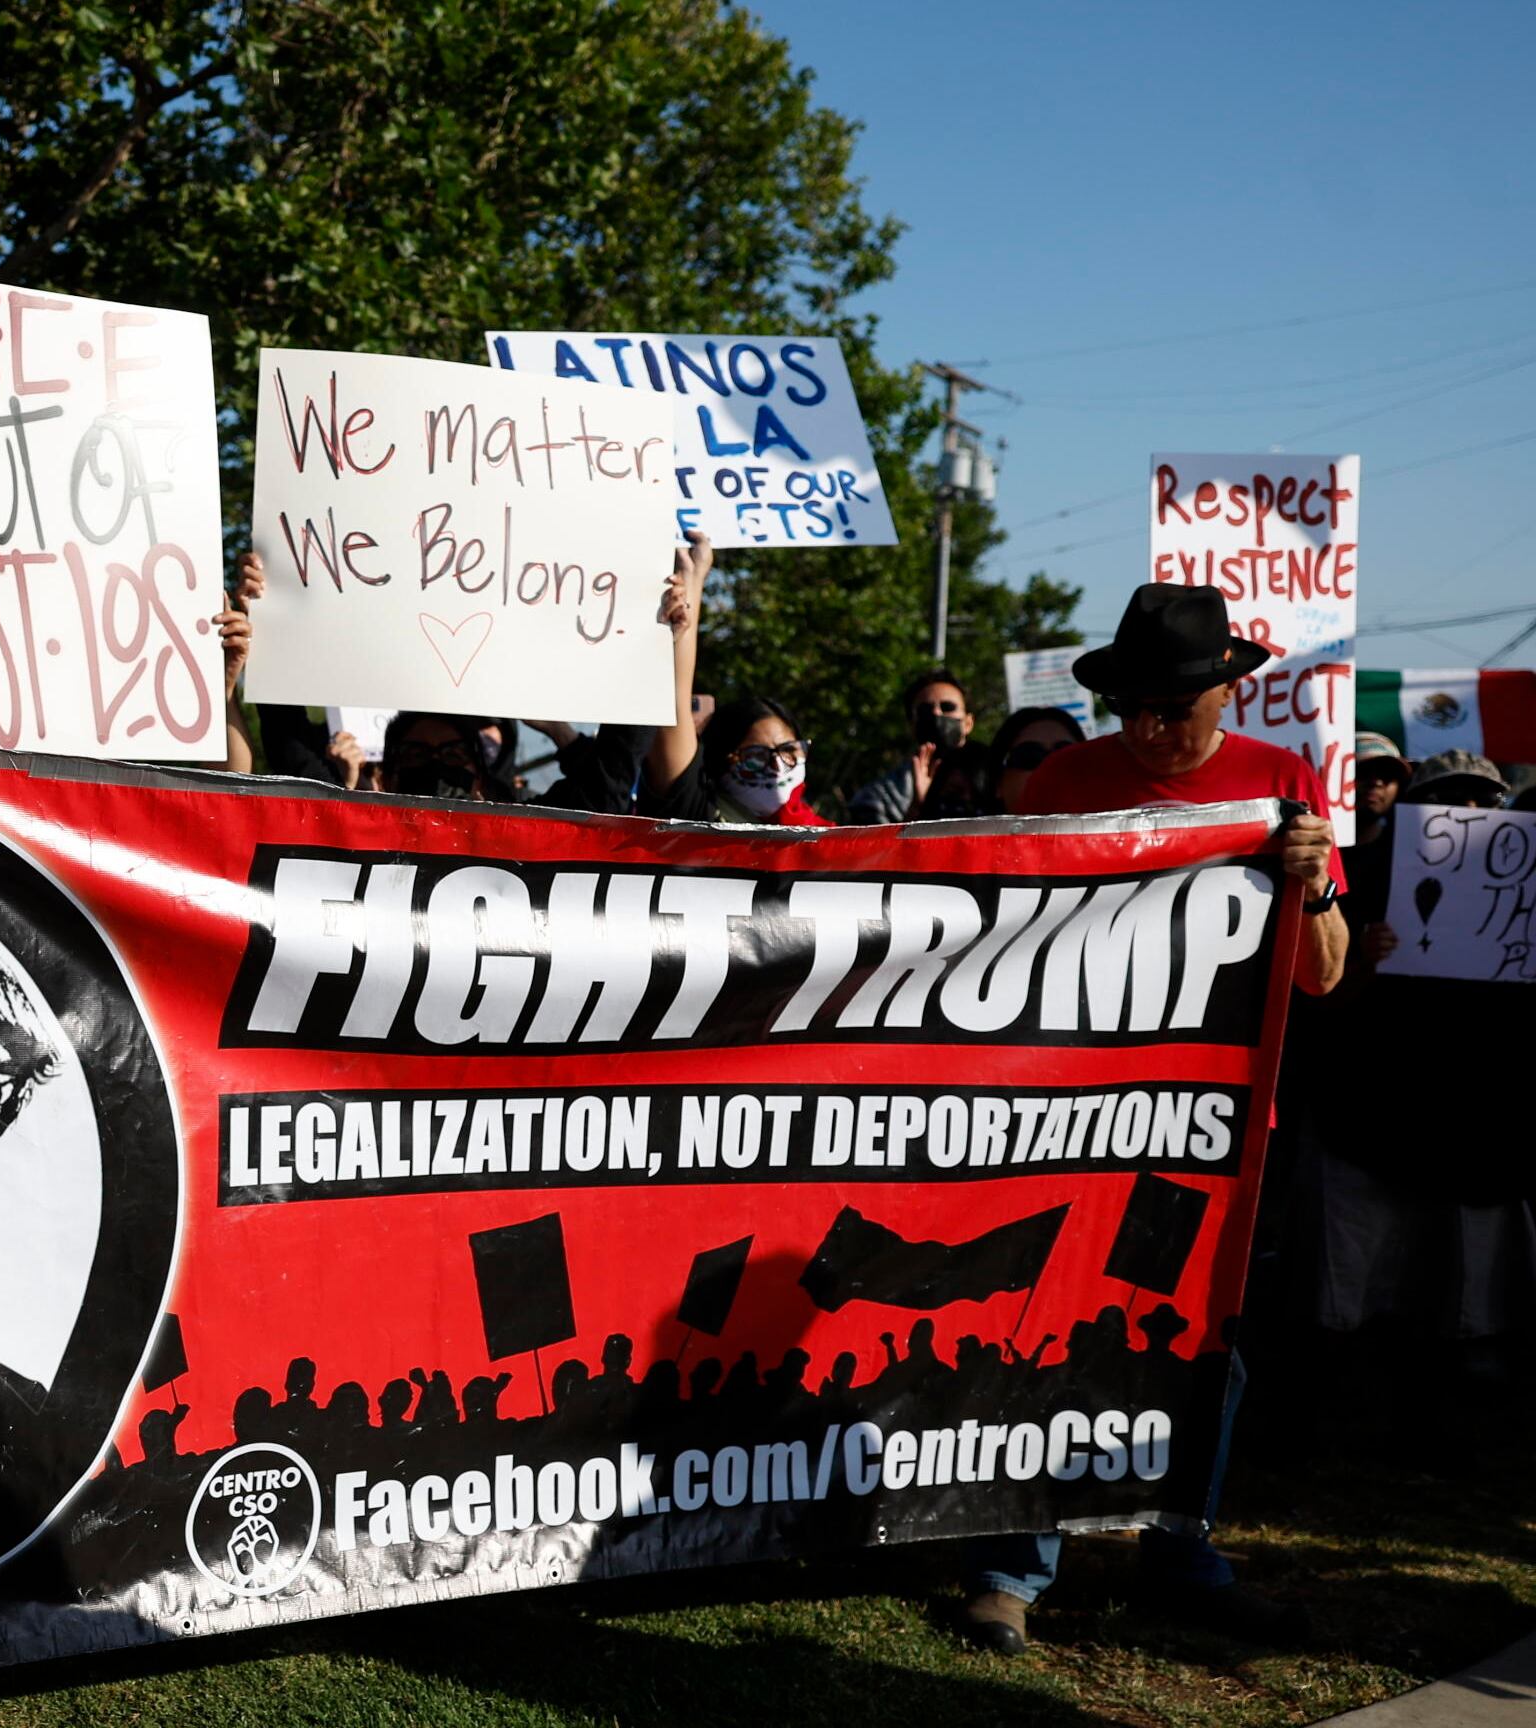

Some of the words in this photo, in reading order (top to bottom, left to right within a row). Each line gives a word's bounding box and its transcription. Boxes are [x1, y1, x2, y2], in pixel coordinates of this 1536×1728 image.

[273, 366, 395, 480] We
[697, 404, 812, 461] LA
[70, 414, 190, 550] OF
[714, 467, 769, 498] OF
[785, 469, 870, 504] OUR
[1156, 463, 1353, 547] Respect
[279, 506, 391, 594] We
[412, 502, 626, 644] Belong.
[1154, 543, 1357, 603] EXISTENCE
[1234, 663, 1351, 727] PECT
[1417, 810, 1536, 882] STO
[1476, 880, 1536, 942] TH
[246, 858, 758, 1046] FIGHT
[770, 865, 1275, 1034] TRUMP
[229, 1095, 662, 1188] LEGALIZATION,
[677, 1094, 802, 1168] NOT
[810, 1091, 1234, 1168] DEPORTATIONS
[208, 1466, 301, 1498] CENTRO
[228, 1492, 278, 1517] CSO
[334, 1409, 1172, 1551] Facebook.com/CentroCSO
